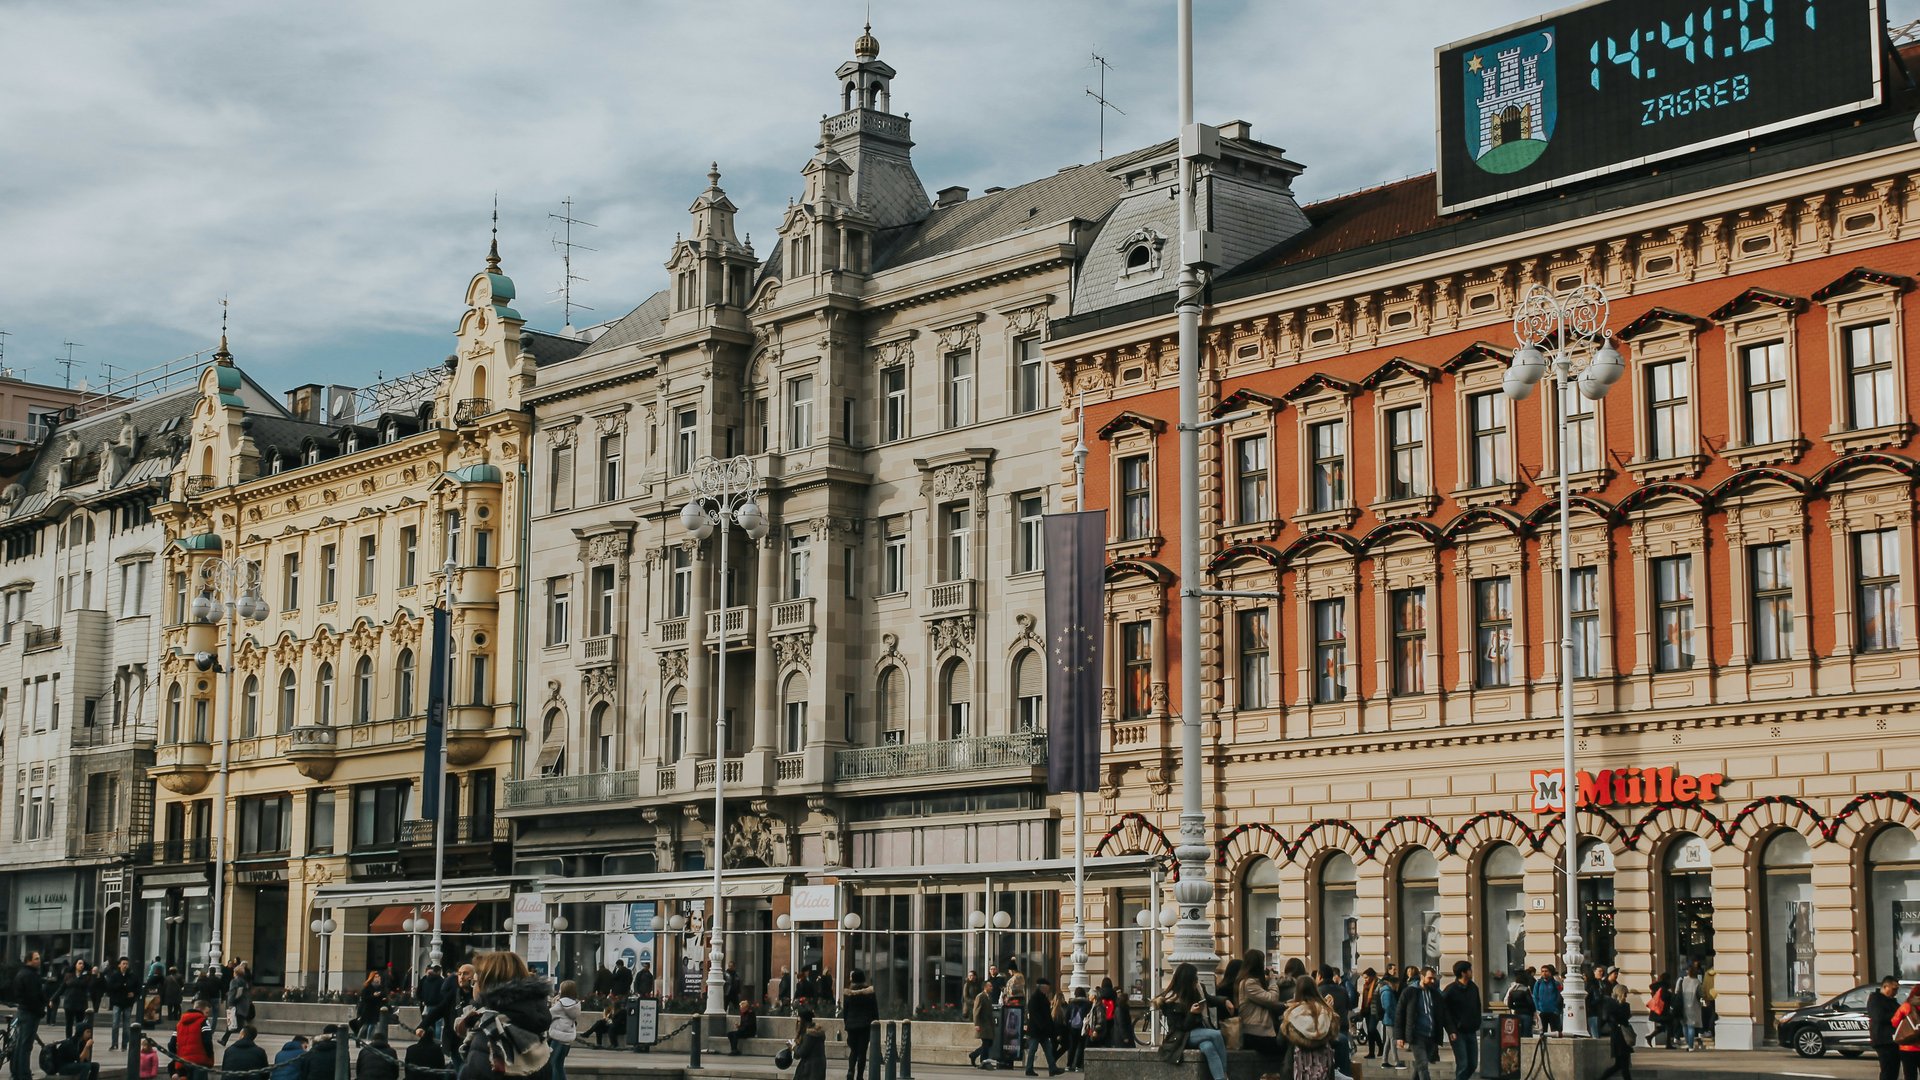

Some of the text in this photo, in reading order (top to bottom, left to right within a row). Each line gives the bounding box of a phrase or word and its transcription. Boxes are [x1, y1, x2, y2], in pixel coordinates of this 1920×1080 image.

[1641, 74, 1749, 126] ZAGREB
[1539, 766, 1723, 807] M Müller
[516, 897, 542, 912] Aida
[795, 890, 831, 909] Aida
[1828, 1020, 1861, 1031] KLEMM
